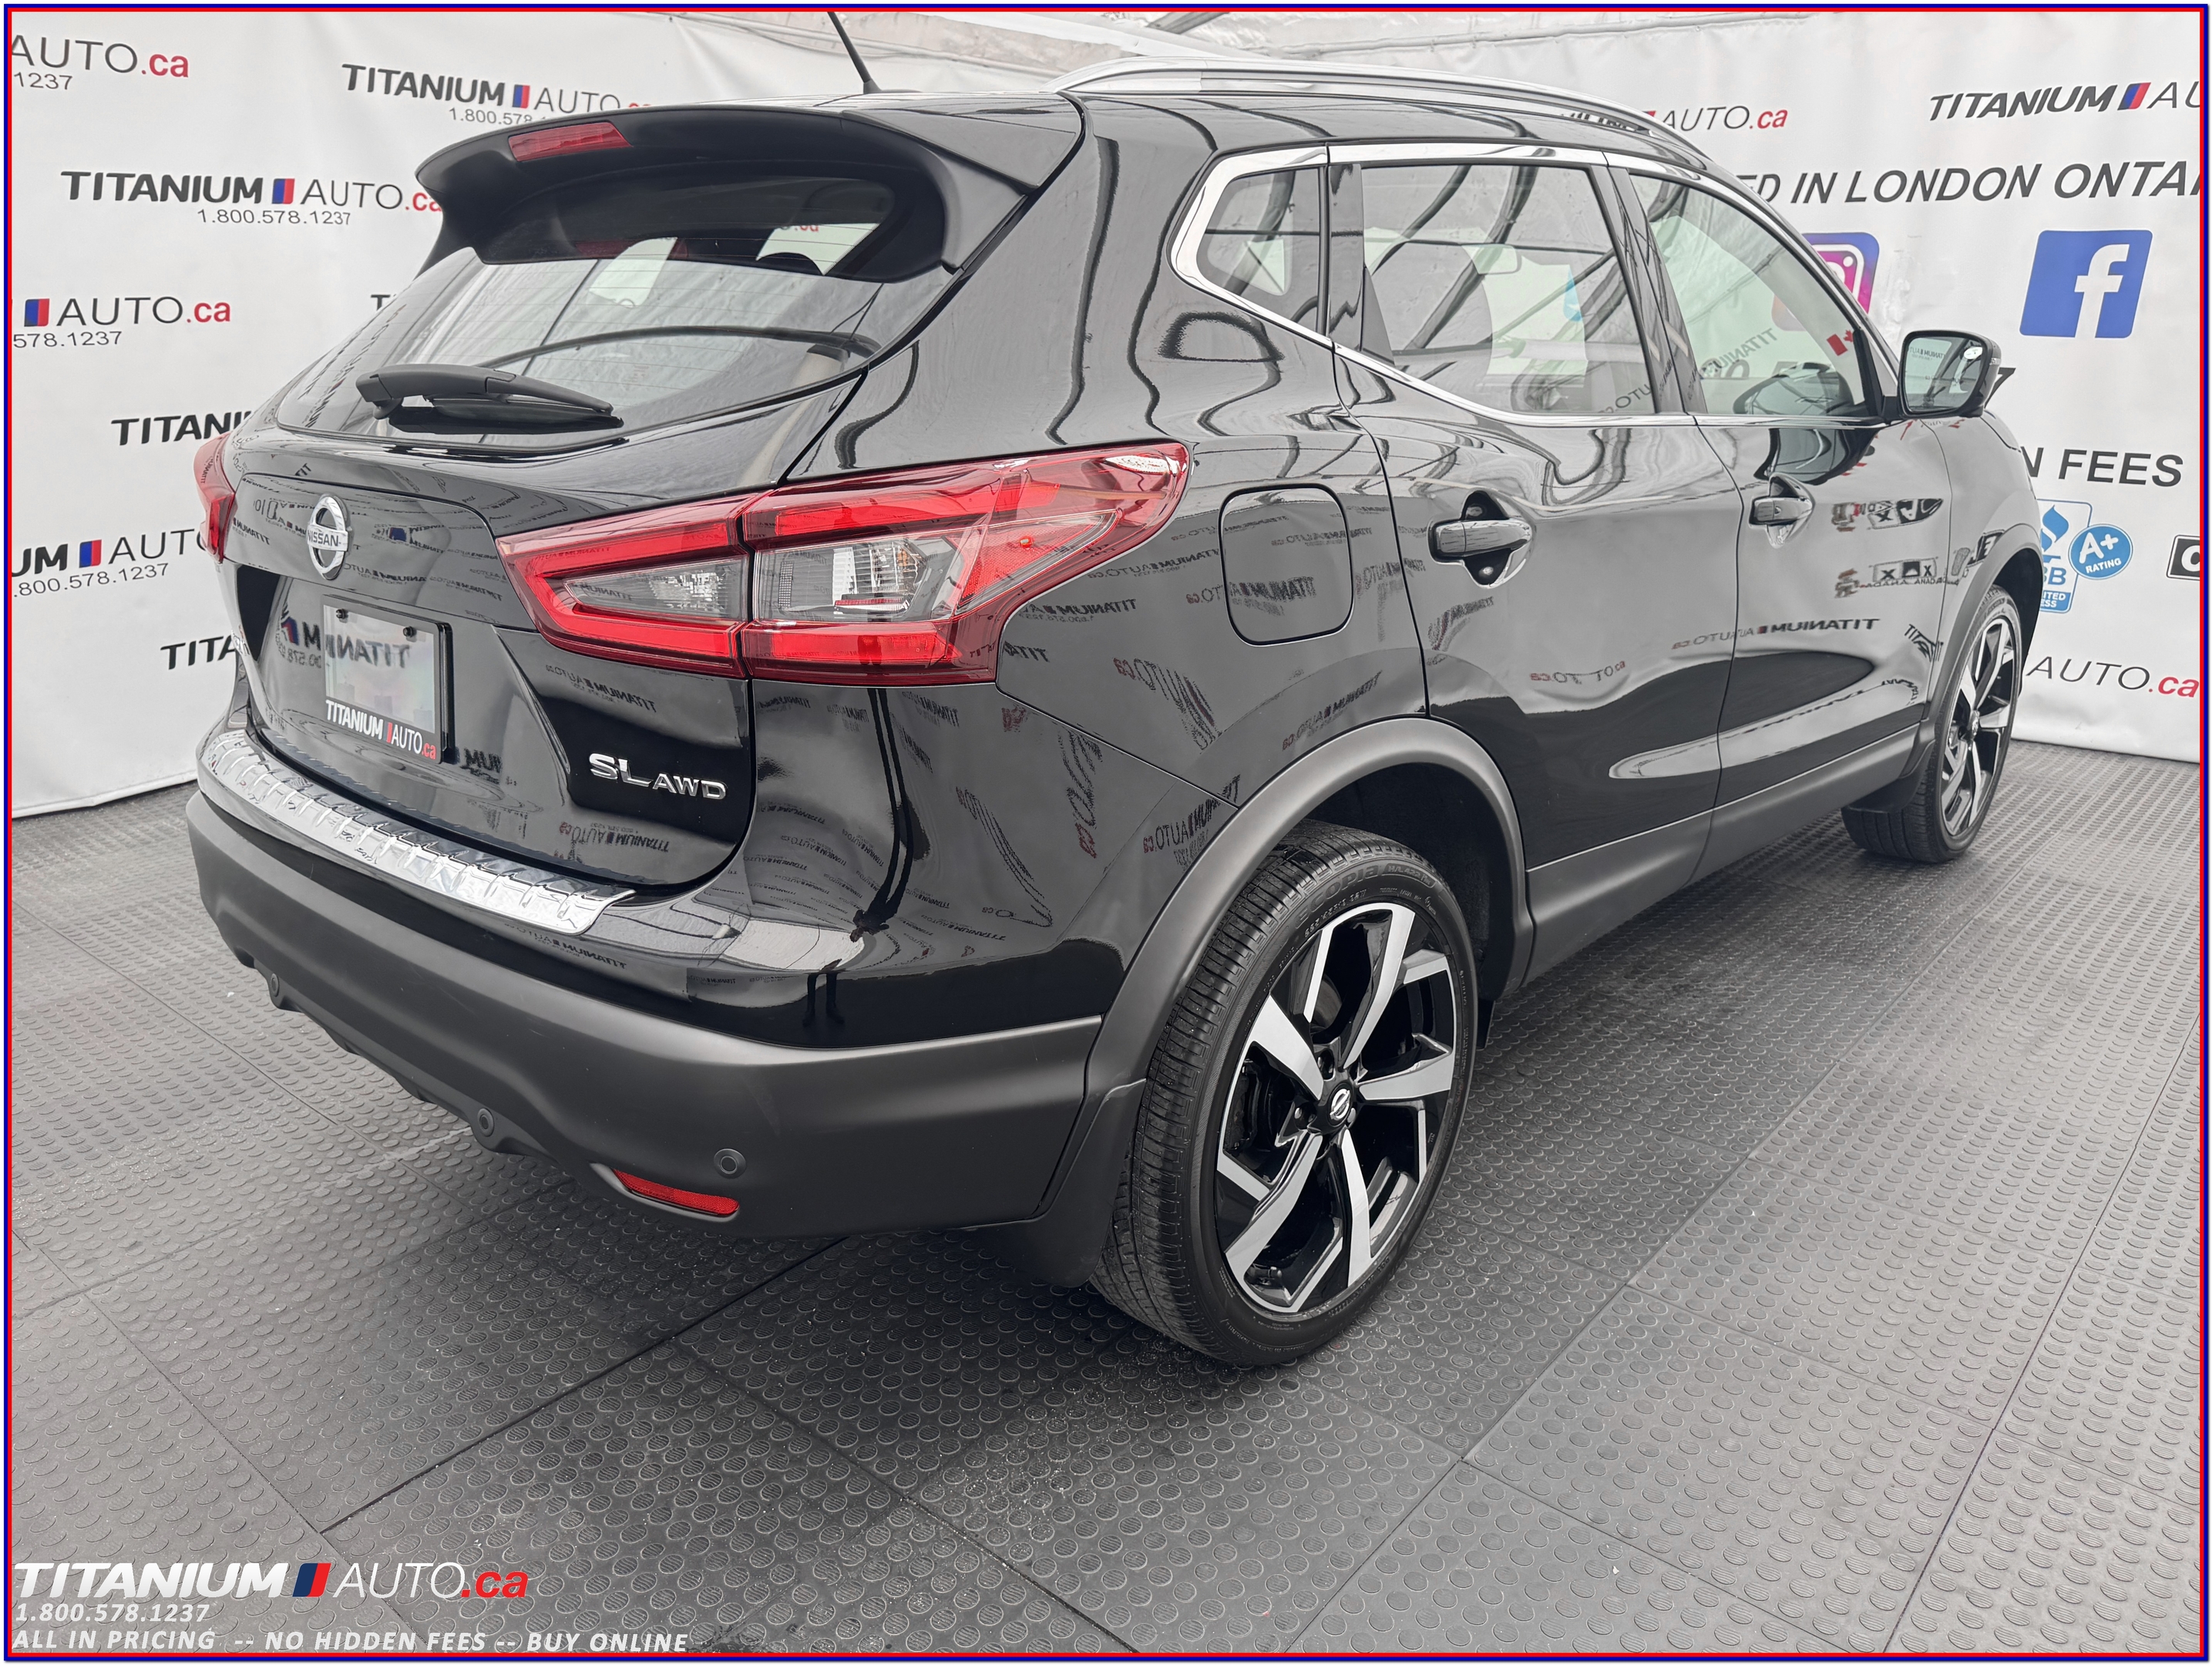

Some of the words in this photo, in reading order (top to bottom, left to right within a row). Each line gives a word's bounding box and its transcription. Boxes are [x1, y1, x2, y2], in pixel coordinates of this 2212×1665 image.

[12, 35, 189, 78] AUTO.ca
[341, 63, 506, 107] TITANIUM
[534, 87, 651, 113] AUTO
[1929, 84, 2119, 121] TITANIUM
[1662, 106, 1788, 131] AUTO.ca
[60, 170, 264, 204] TITANIUM
[1790, 171, 1839, 204] IN
[1844, 163, 2044, 204] LONDON
[2055, 160, 2200, 199] ONTA
[197, 209, 351, 226] 1.800.578.1237
[55, 296, 231, 327] AUTO.ca
[110, 410, 251, 446] TITANI
[2058, 449, 2183, 487] FEES
[308, 529, 341, 548] NISSAN
[2079, 532, 2119, 563] A+
[2086, 557, 2122, 574] RATING
[2025, 655, 2200, 698] AUTO.ca
[324, 699, 385, 740] TITANIUM
[391, 723, 437, 760] AUTO.ca
[588, 752, 654, 788] SL
[652, 772, 728, 800] AWD
